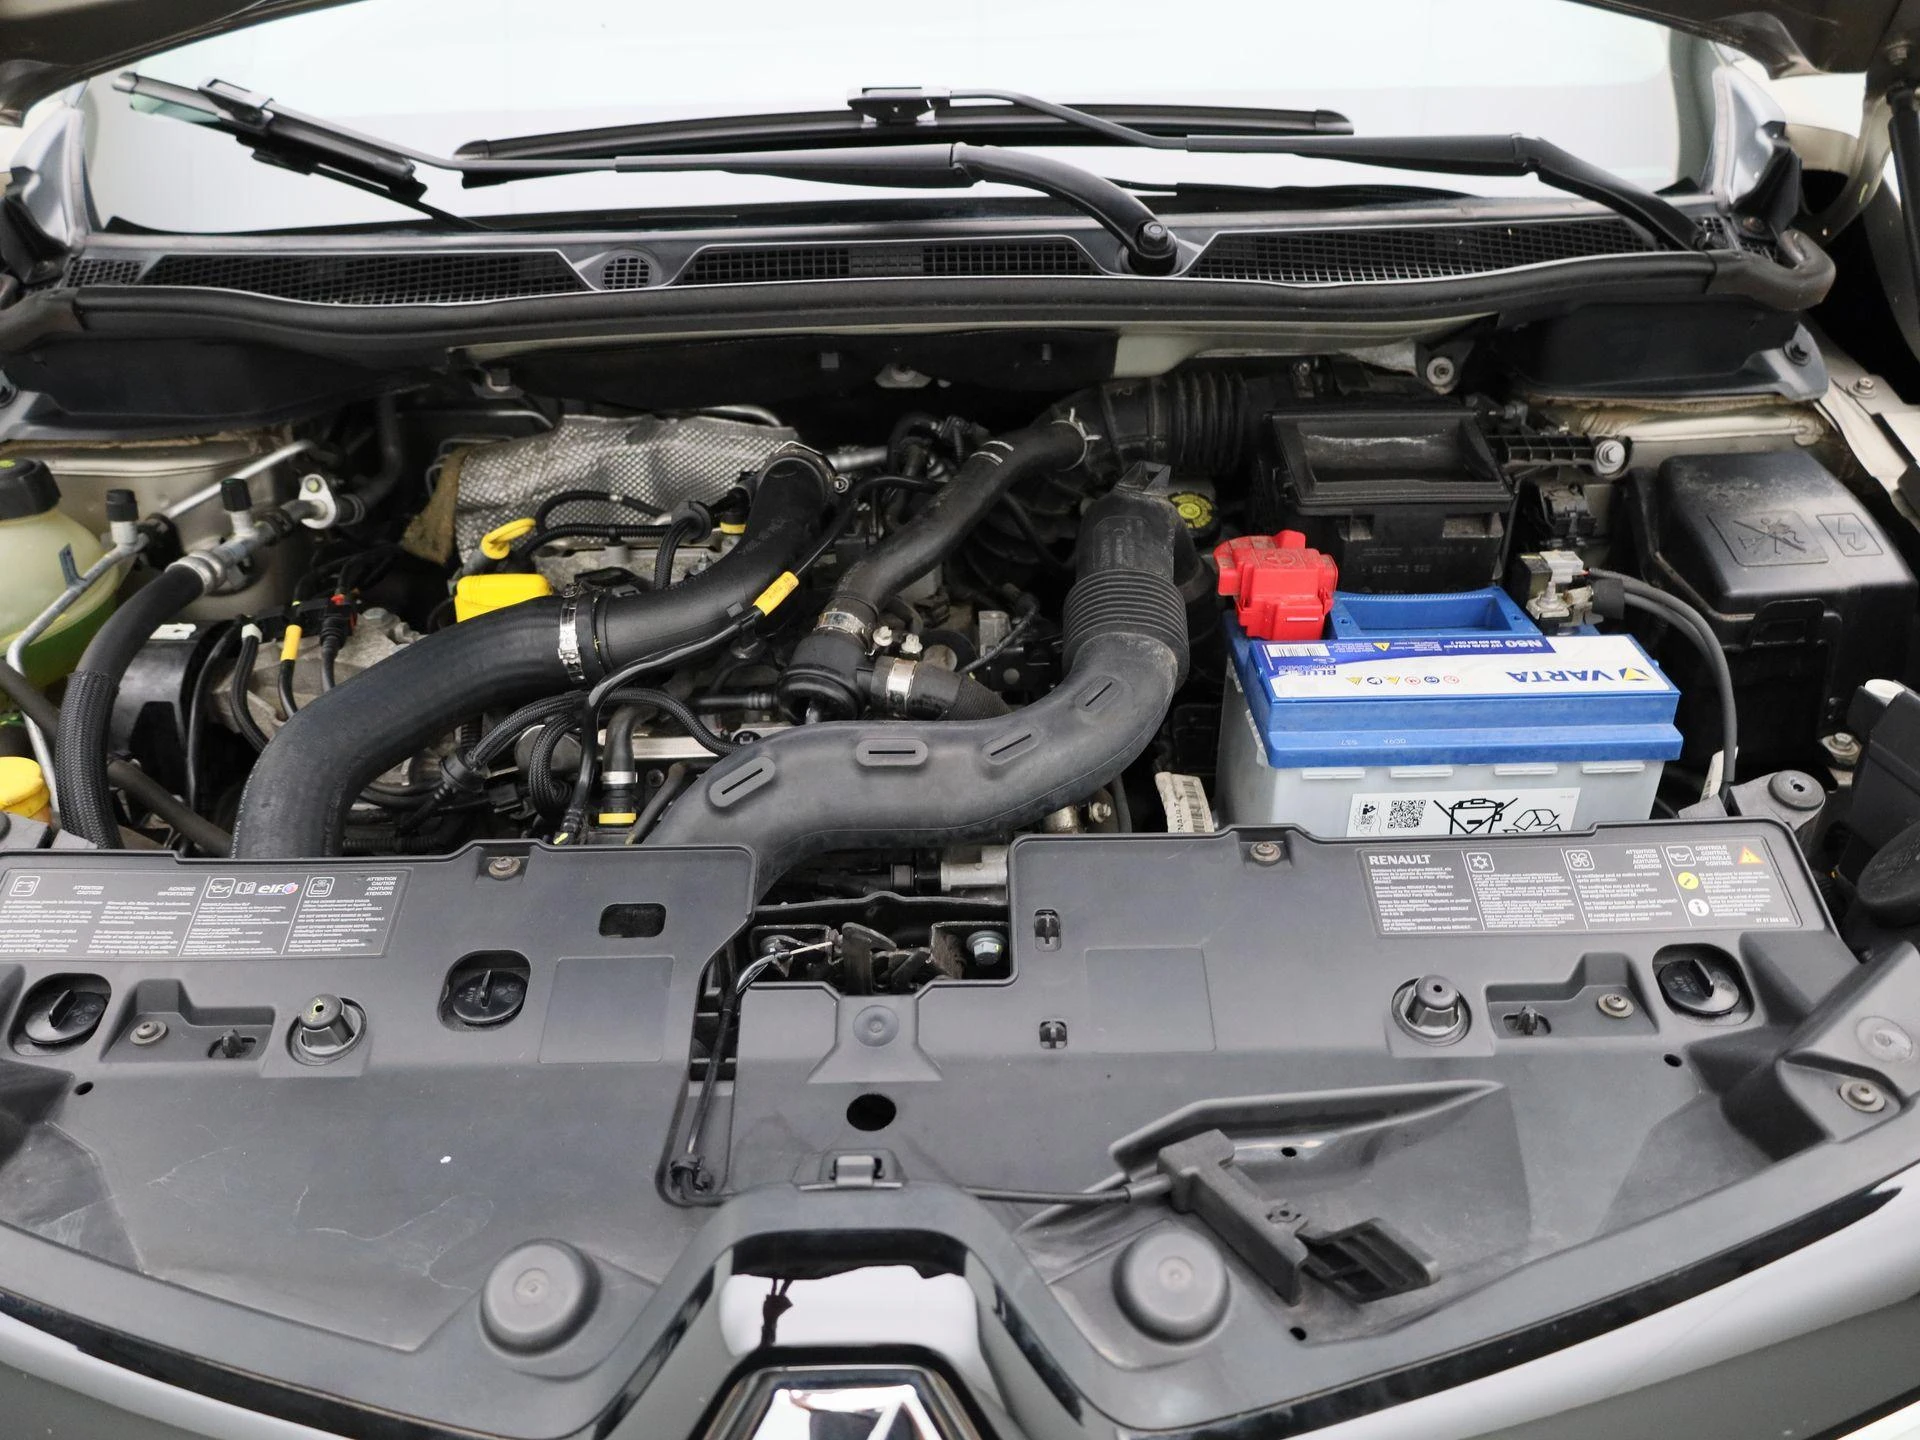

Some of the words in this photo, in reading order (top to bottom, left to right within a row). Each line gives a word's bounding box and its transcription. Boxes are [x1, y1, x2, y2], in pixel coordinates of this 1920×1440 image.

[1506, 670, 1615, 683] VARTA
[1368, 854, 1431, 865] RENAULT
[258, 884, 285, 893] elf
